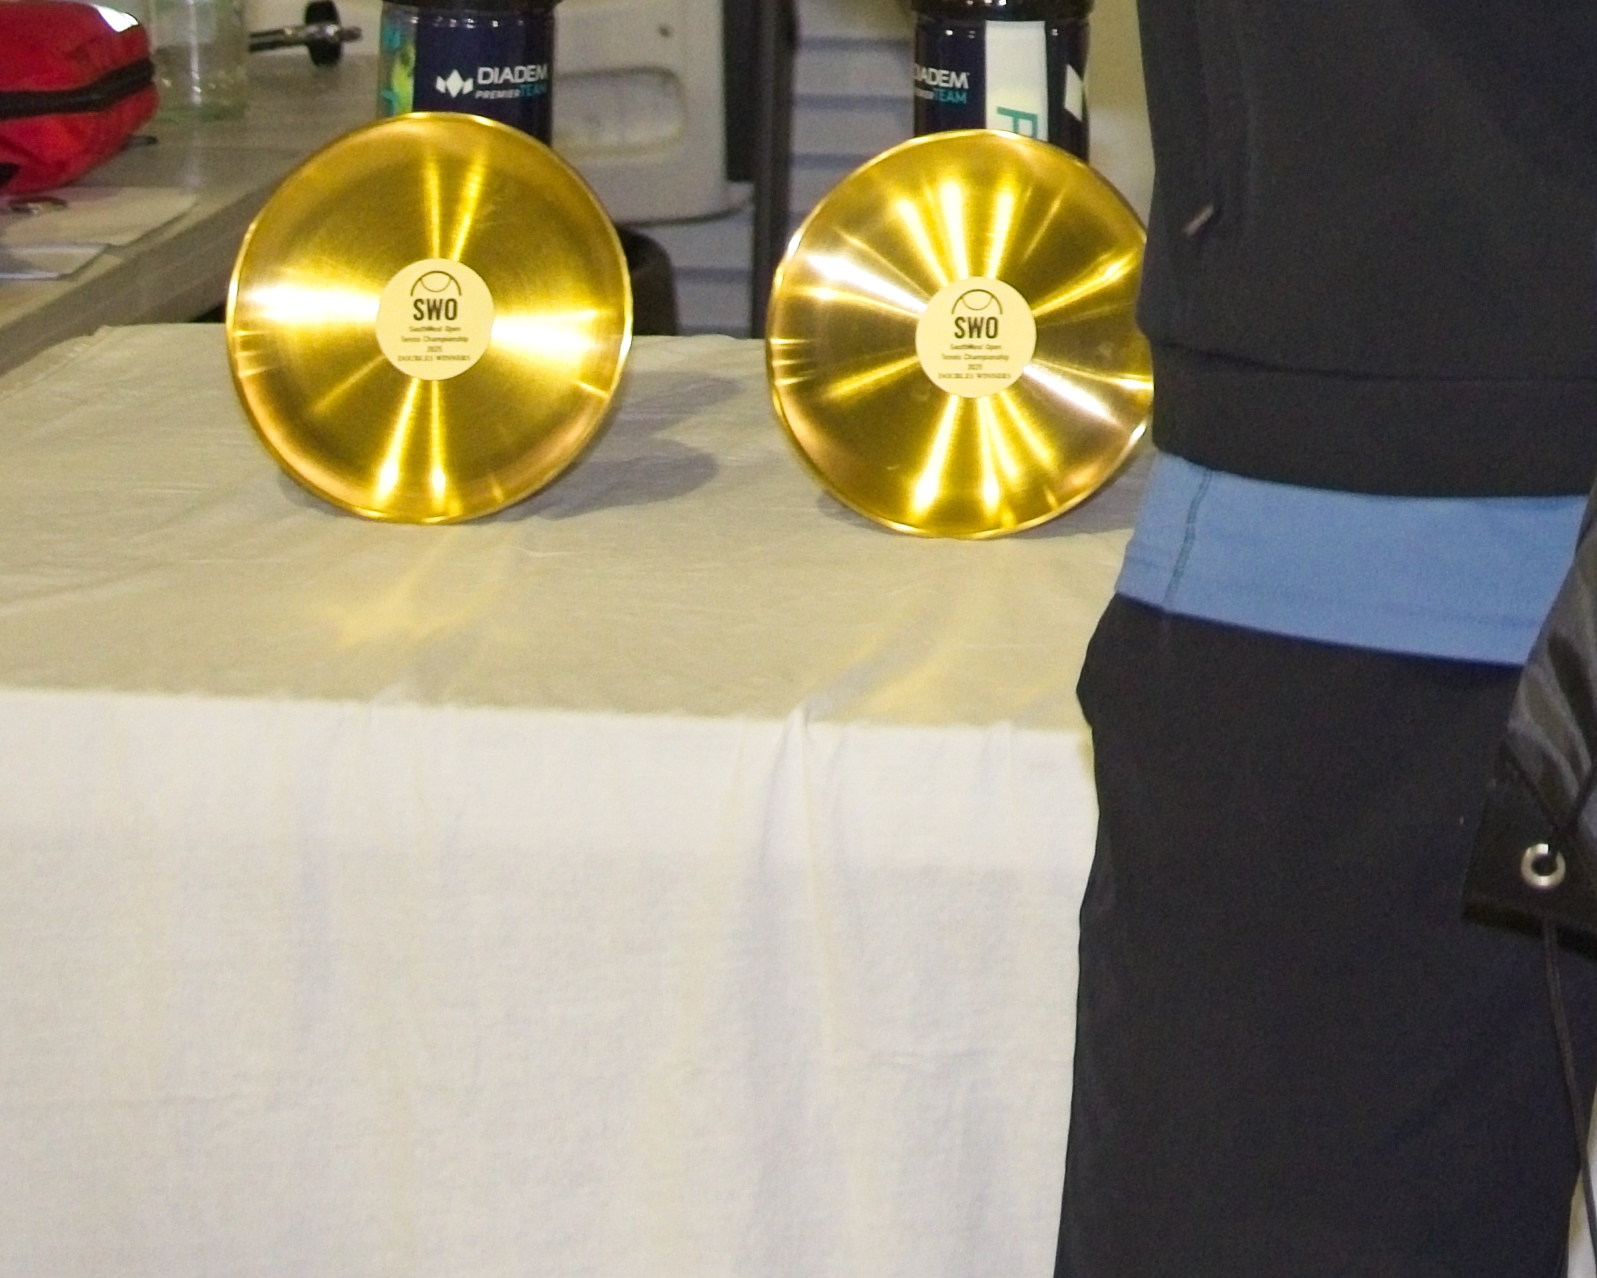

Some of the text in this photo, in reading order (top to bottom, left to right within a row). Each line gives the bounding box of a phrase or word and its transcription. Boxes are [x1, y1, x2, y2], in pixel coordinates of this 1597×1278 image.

[477, 64, 548, 85] DIADEM
[413, 298, 458, 321] SWO
[954, 316, 998, 339] SWO
